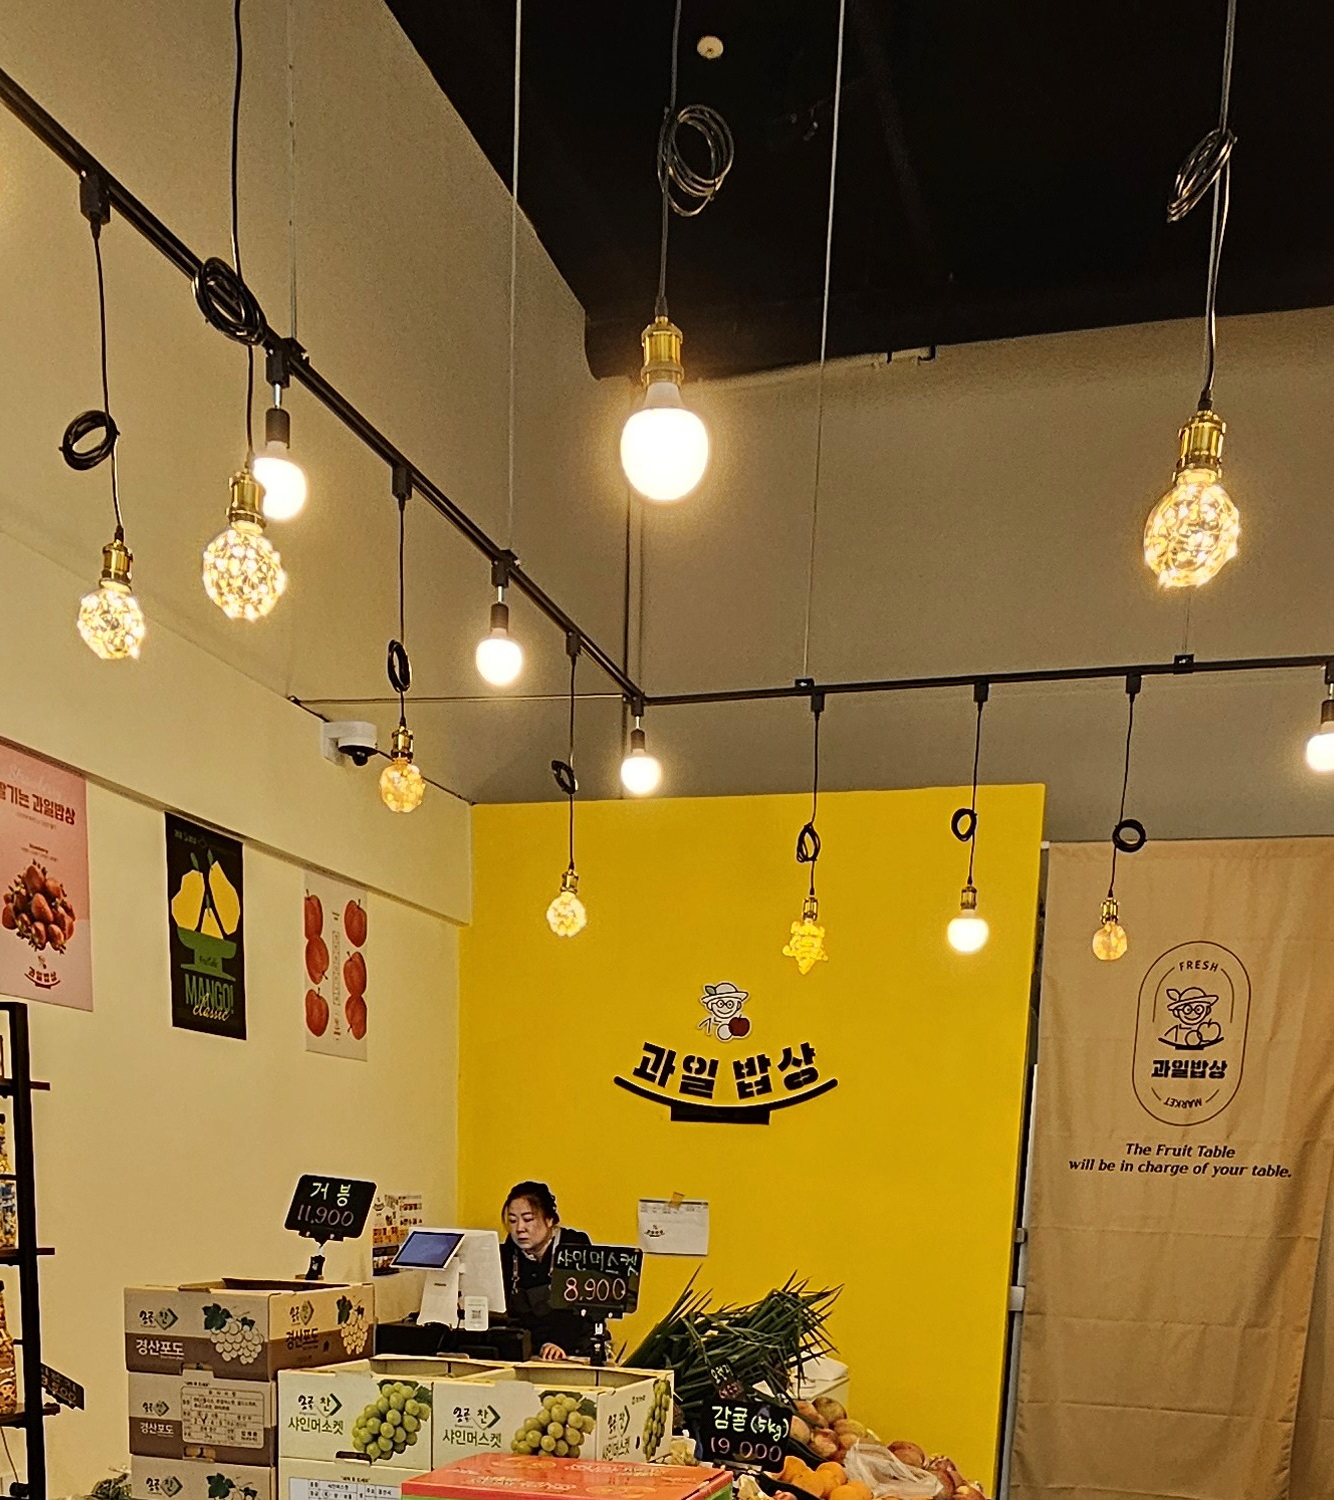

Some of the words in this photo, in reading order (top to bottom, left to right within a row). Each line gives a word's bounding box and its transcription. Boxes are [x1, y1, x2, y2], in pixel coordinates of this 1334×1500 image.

[32, 793, 75, 825] 과일밥상
[1179, 960, 1219, 972] FRESH
[185, 973, 234, 1013] MANGO!
[193, 992, 231, 1021] classic
[1151, 1059, 1228, 1079] 과일밥상
[1163, 1097, 1203, 1109] MARKET
[1125, 1143, 1152, 1156] The
[1156, 1144, 1192, 1158] Fruit
[1197, 1145, 1236, 1158] Table
[1069, 1159, 1094, 1171] will
[1099, 1160, 1115, 1171] be
[1120, 1160, 1134, 1172] in
[1138, 1161, 1188, 1177] charge
[1193, 1162, 1209, 1175] of
[1211, 1165, 1248, 1178] your
[1251, 1164, 1292, 1178] table.
[556, 1250, 638, 1276] 샤인머스켓
[136, 1340, 185, 1357] 경산포도
[140, 1422, 174, 1435] 경산포도
[711, 1406, 748, 1432] 감귤
[750, 1415, 789, 1441] (5kg)
[443, 1428, 502, 1448] 샤인머스켓
